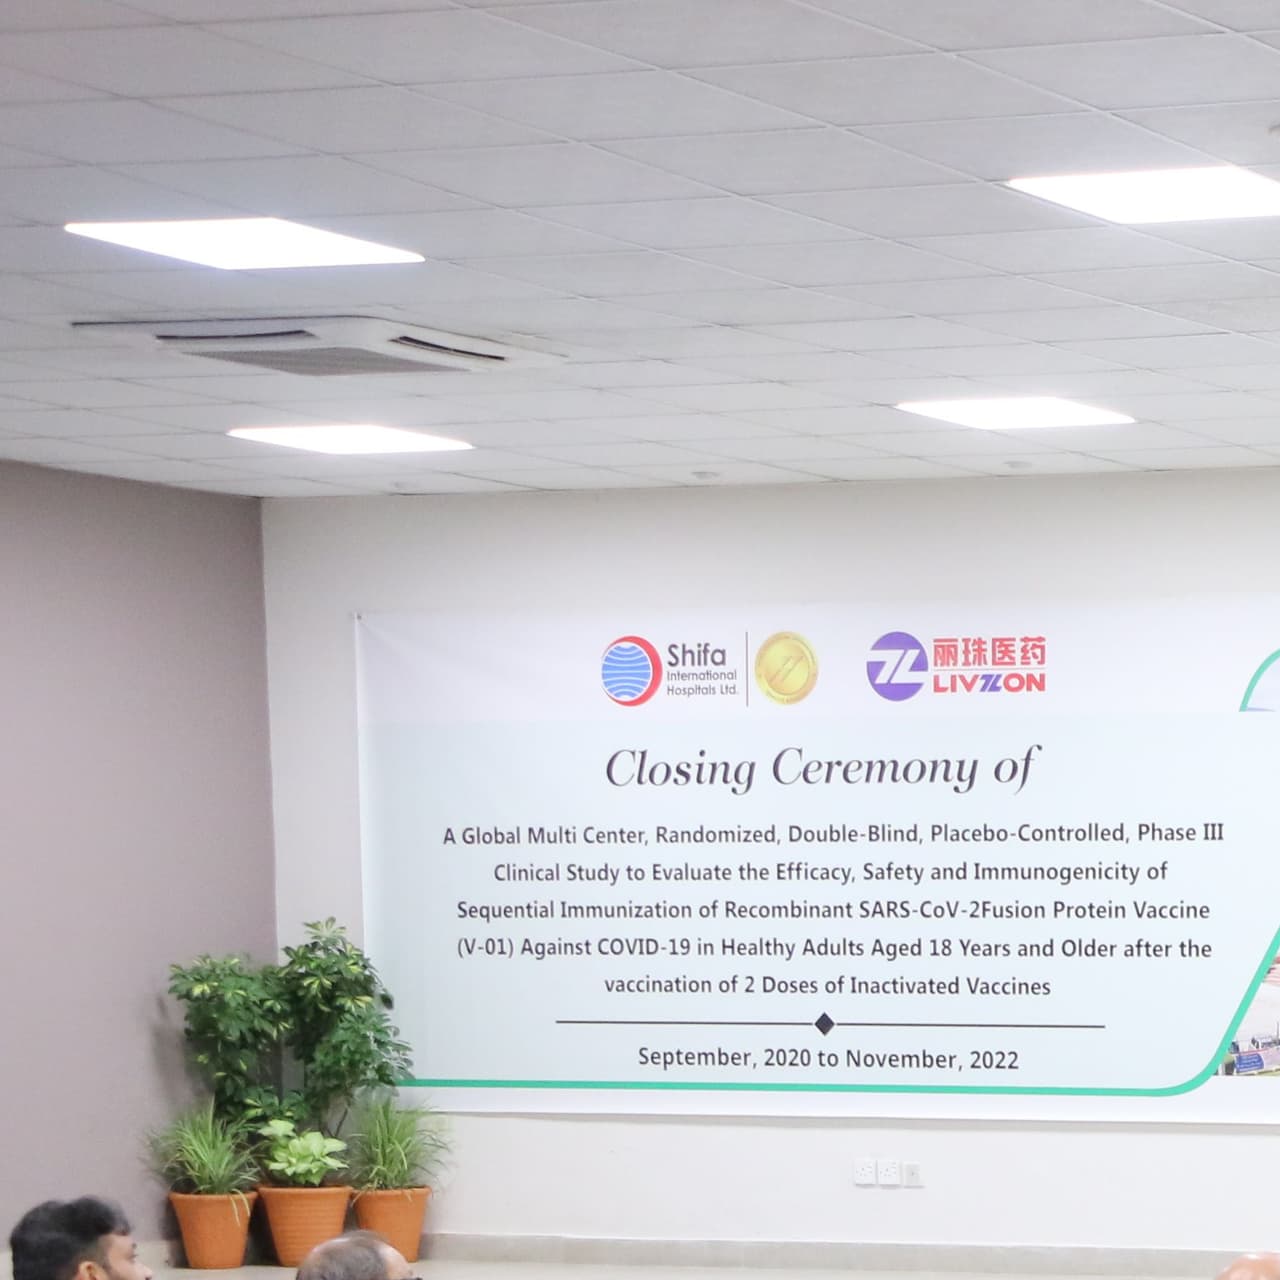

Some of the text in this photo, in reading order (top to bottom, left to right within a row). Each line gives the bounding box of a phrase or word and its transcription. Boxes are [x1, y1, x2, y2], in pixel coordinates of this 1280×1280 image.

[666, 643, 727, 668] Shifa
[932, 636, 1047, 667] 丽珠医药
[666, 669, 738, 682] International
[666, 683, 740, 699] Hospitals Ltd.
[605, 743, 1043, 796] Closing Ceremony of
[442, 827, 457, 845] A
[461, 825, 521, 845] Global
[527, 825, 577, 845] Multi
[582, 825, 649, 847] Center,
[655, 823, 781, 846] Randomized,
[788, 823, 924, 846] Double-Blind,
[930, 822, 1130, 845] Placebo-Controlled,
[1138, 821, 1197, 842] Phase
[493, 860, 1169, 887] Clinical Study to Evaluate the Efficacy, Safety and Immunogenicity of
[457, 899, 1211, 924] Sequential Immunization of Recombinant SARS-CoV-2Fusion Protein Vaccine
[457, 936, 1213, 962] (V-01) Against COVID-19 in Healthy Adults Aged 18 Years and Older after the
[604, 973, 1052, 996] vaccination of 2 Doses of Inactivated Vaccines
[638, 1046, 1020, 1073] September, 2020 to November, 2022
